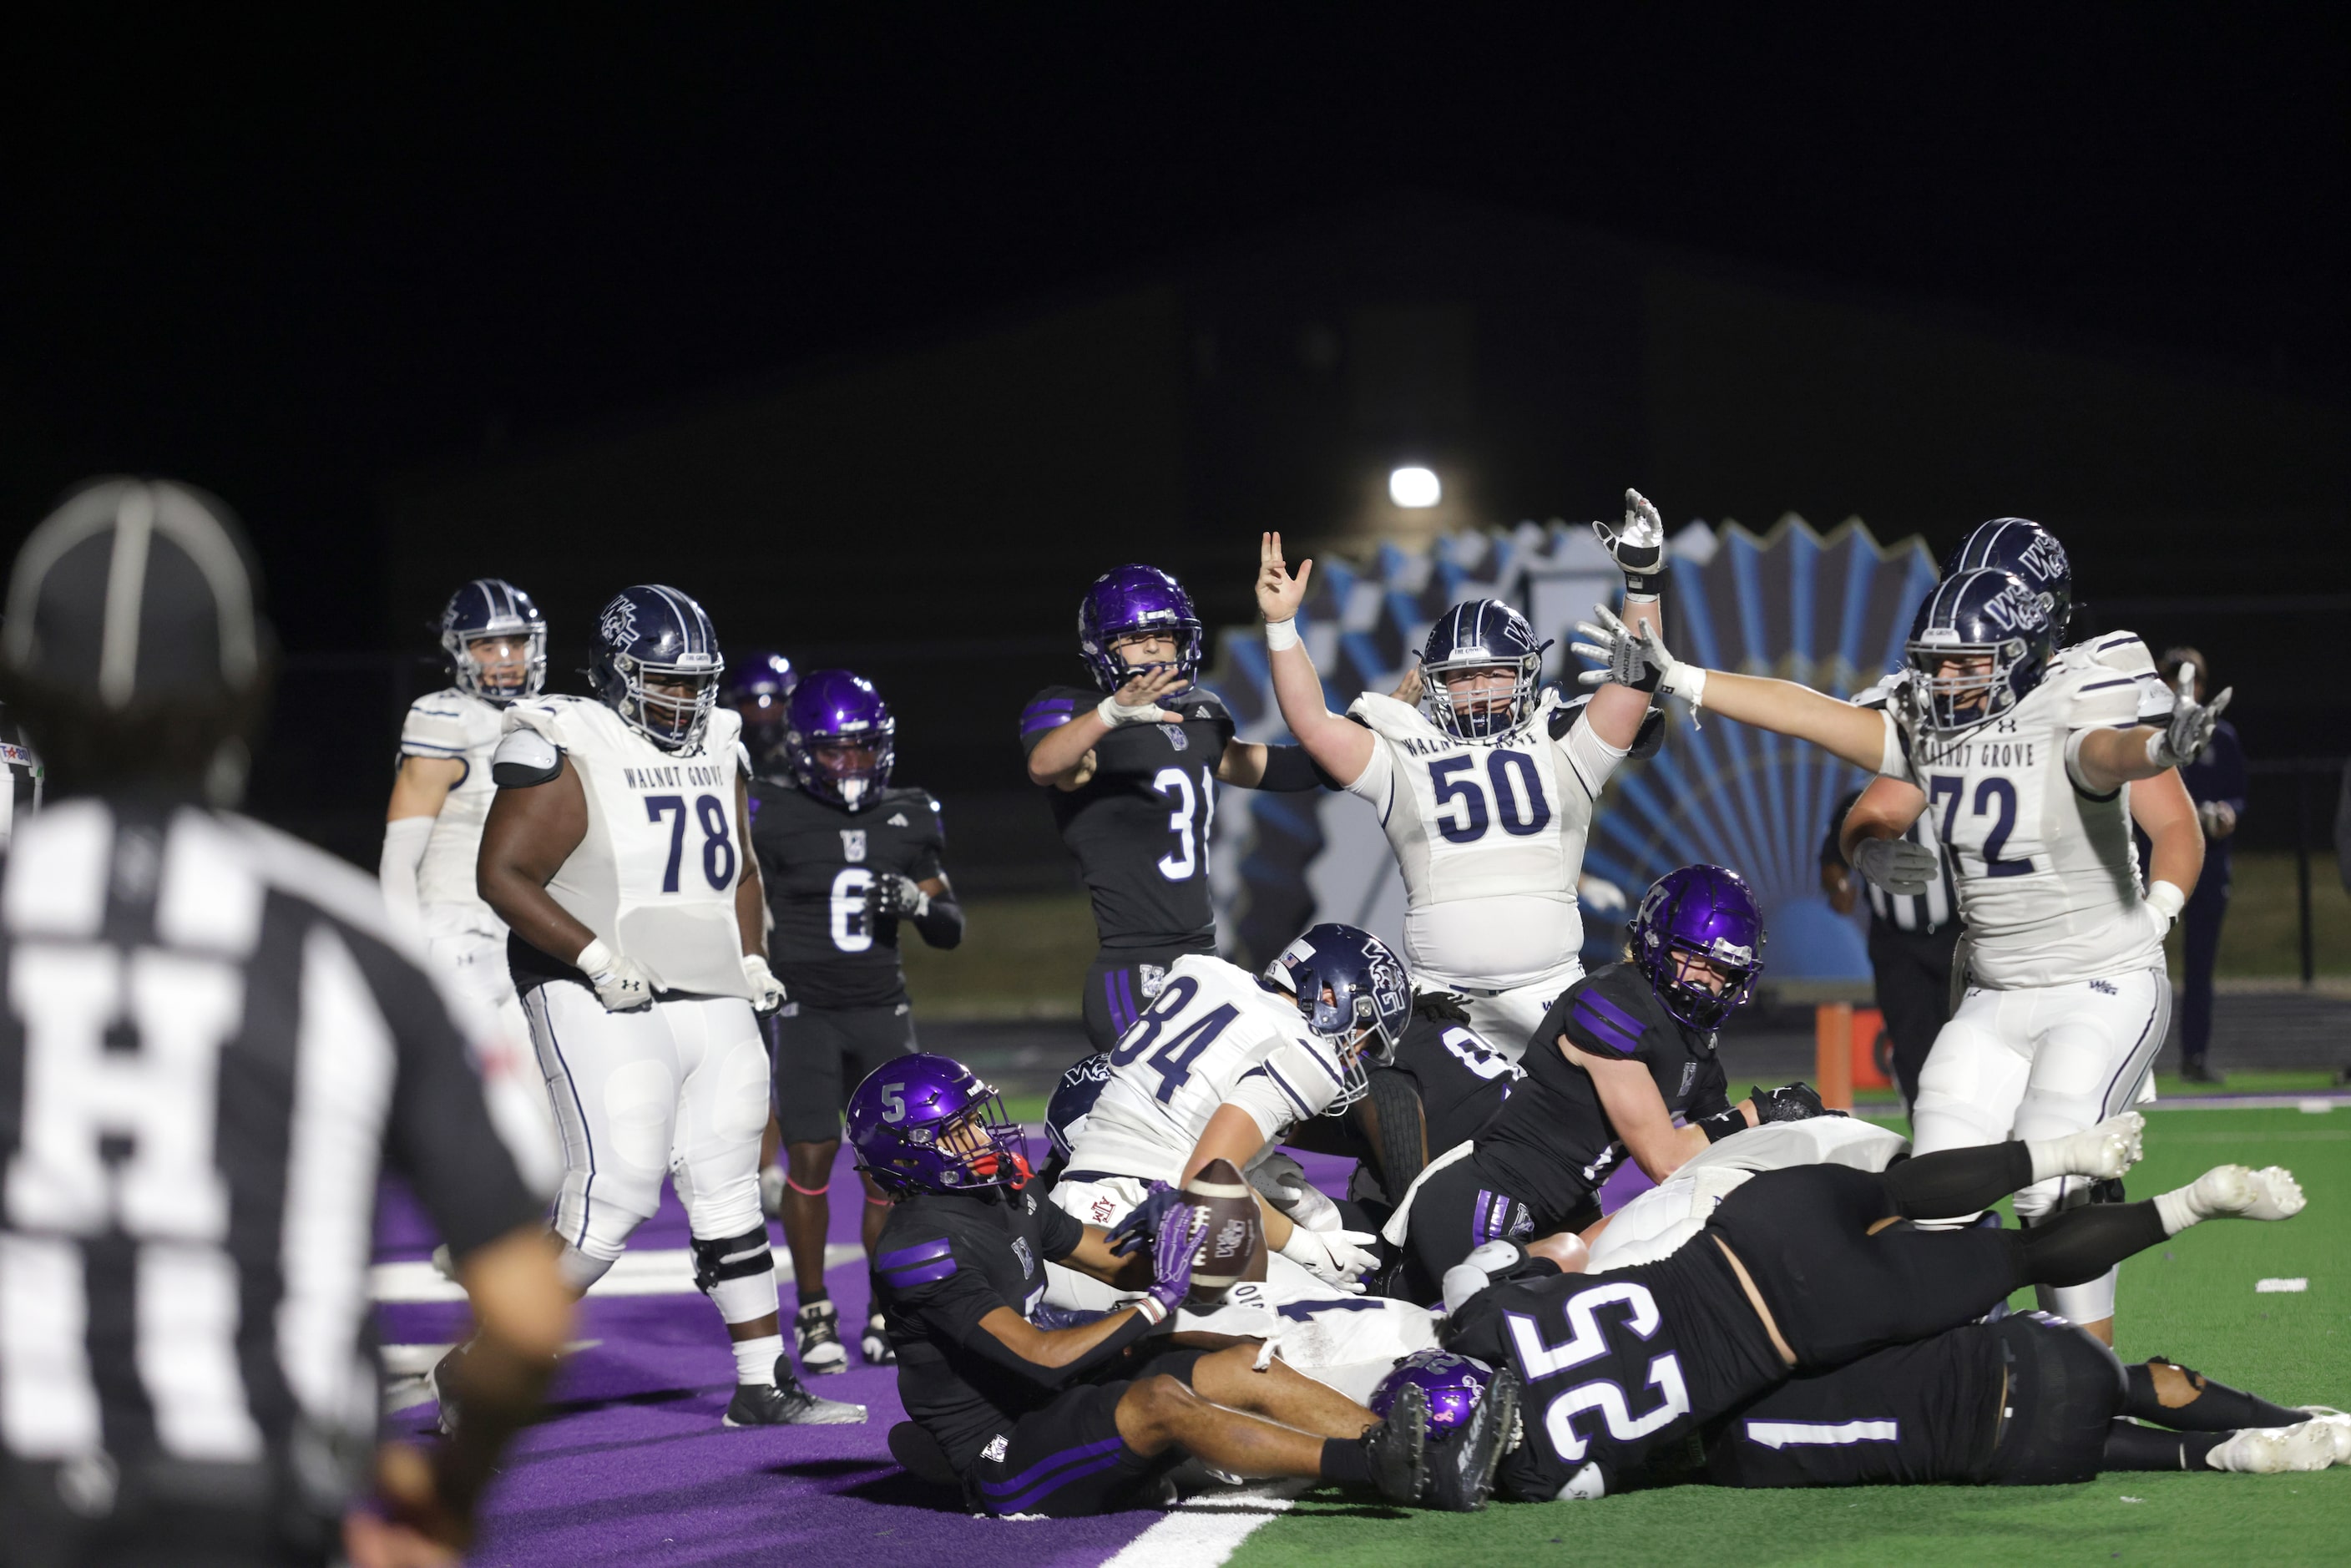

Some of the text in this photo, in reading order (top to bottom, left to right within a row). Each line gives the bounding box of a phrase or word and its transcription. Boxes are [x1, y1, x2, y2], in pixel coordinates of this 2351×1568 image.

[624, 766, 682, 789] WALNUT
[1428, 748, 1551, 844] 50
[1982, 744, 2035, 767] GROVE
[642, 793, 736, 893] 78
[1153, 765, 1215, 881] 31
[1929, 774, 2035, 878] 72
[1110, 974, 1243, 1105] 84
[882, 1083, 906, 1123] 5
[1276, 1297, 1386, 1323] 1
[1504, 1281, 1691, 1462] 25
[1745, 1418, 1898, 1451] 1
